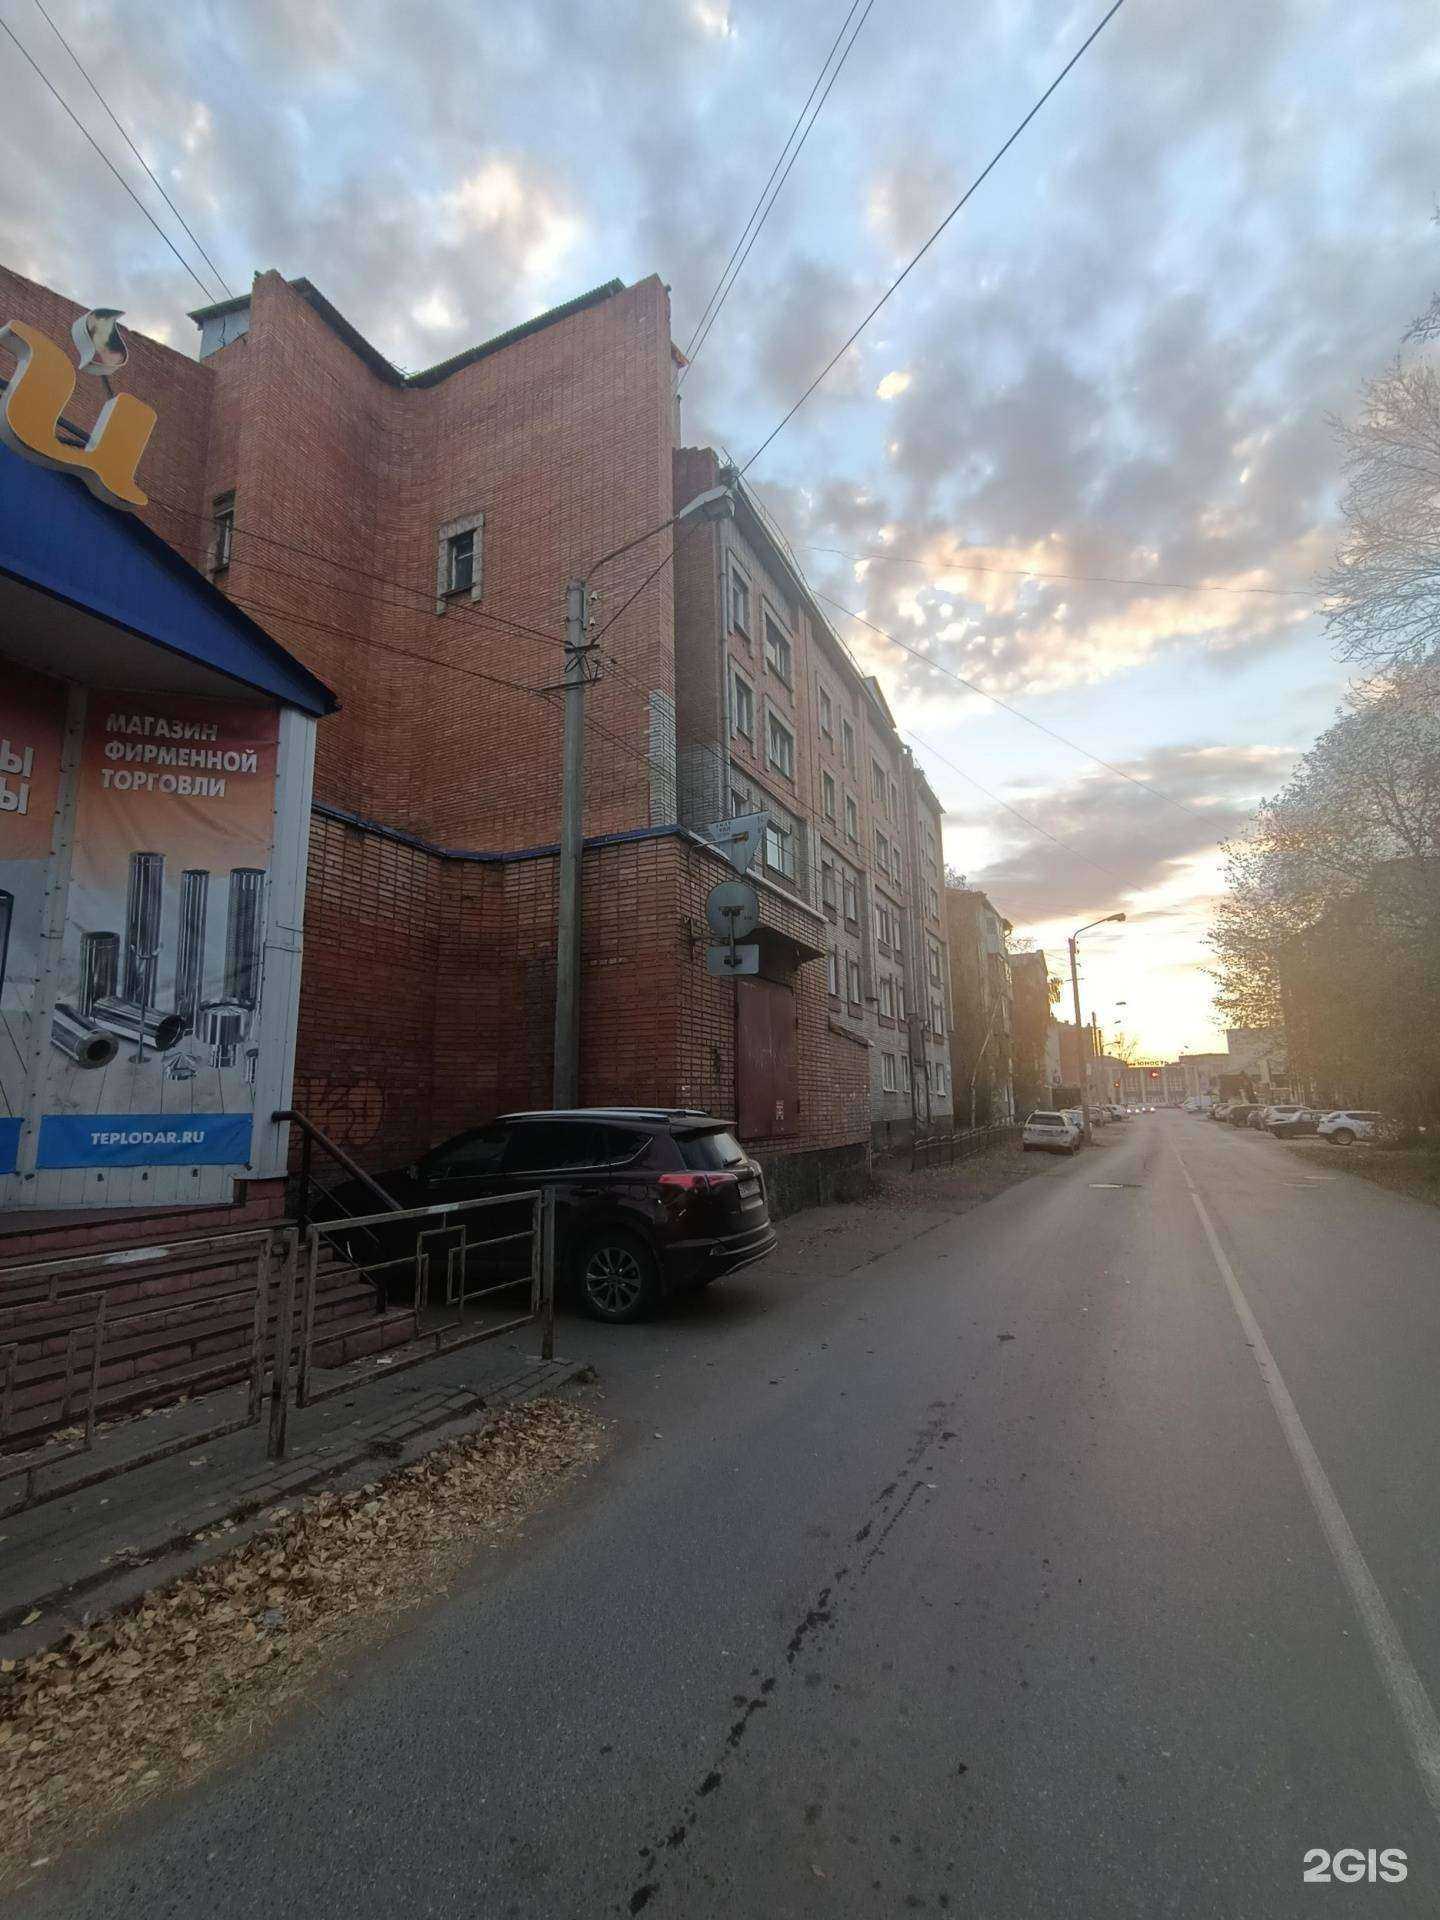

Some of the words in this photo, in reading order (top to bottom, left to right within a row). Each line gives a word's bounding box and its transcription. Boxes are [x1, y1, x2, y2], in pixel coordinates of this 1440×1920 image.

[105, 713, 218, 741] МАГАЗИН
[104, 740, 258, 773] ФИРМЕННОЙ
[101, 769, 226, 798] ТОРГОВЛИ
[91, 1131, 204, 1145] TEPLODAR.RU
